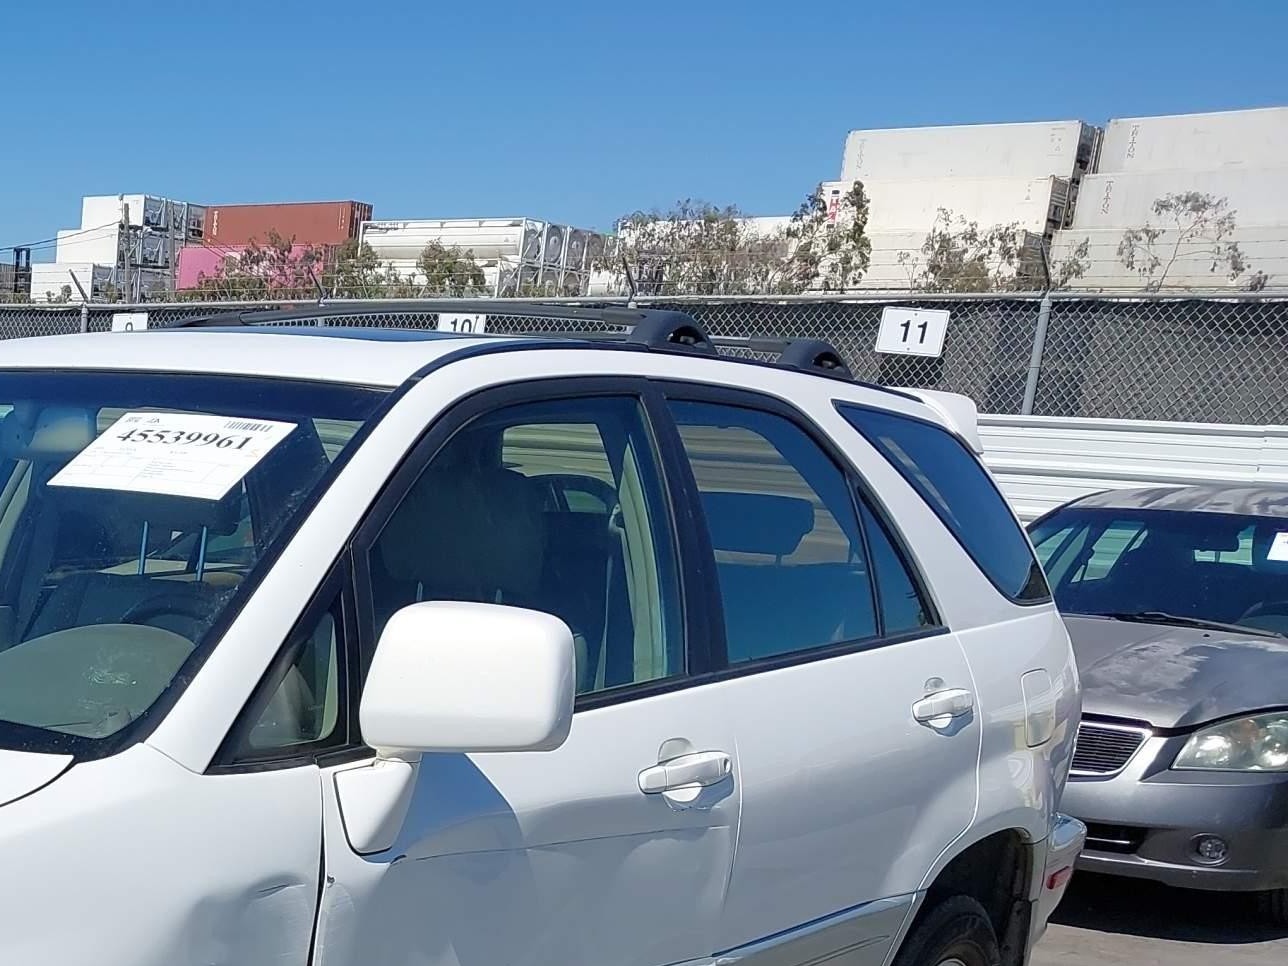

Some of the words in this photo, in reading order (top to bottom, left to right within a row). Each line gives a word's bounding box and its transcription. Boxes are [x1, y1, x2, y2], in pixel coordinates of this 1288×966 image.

[450, 318, 473, 333] 10
[900, 319, 929, 344] 11
[116, 426, 254, 451] 45539961
